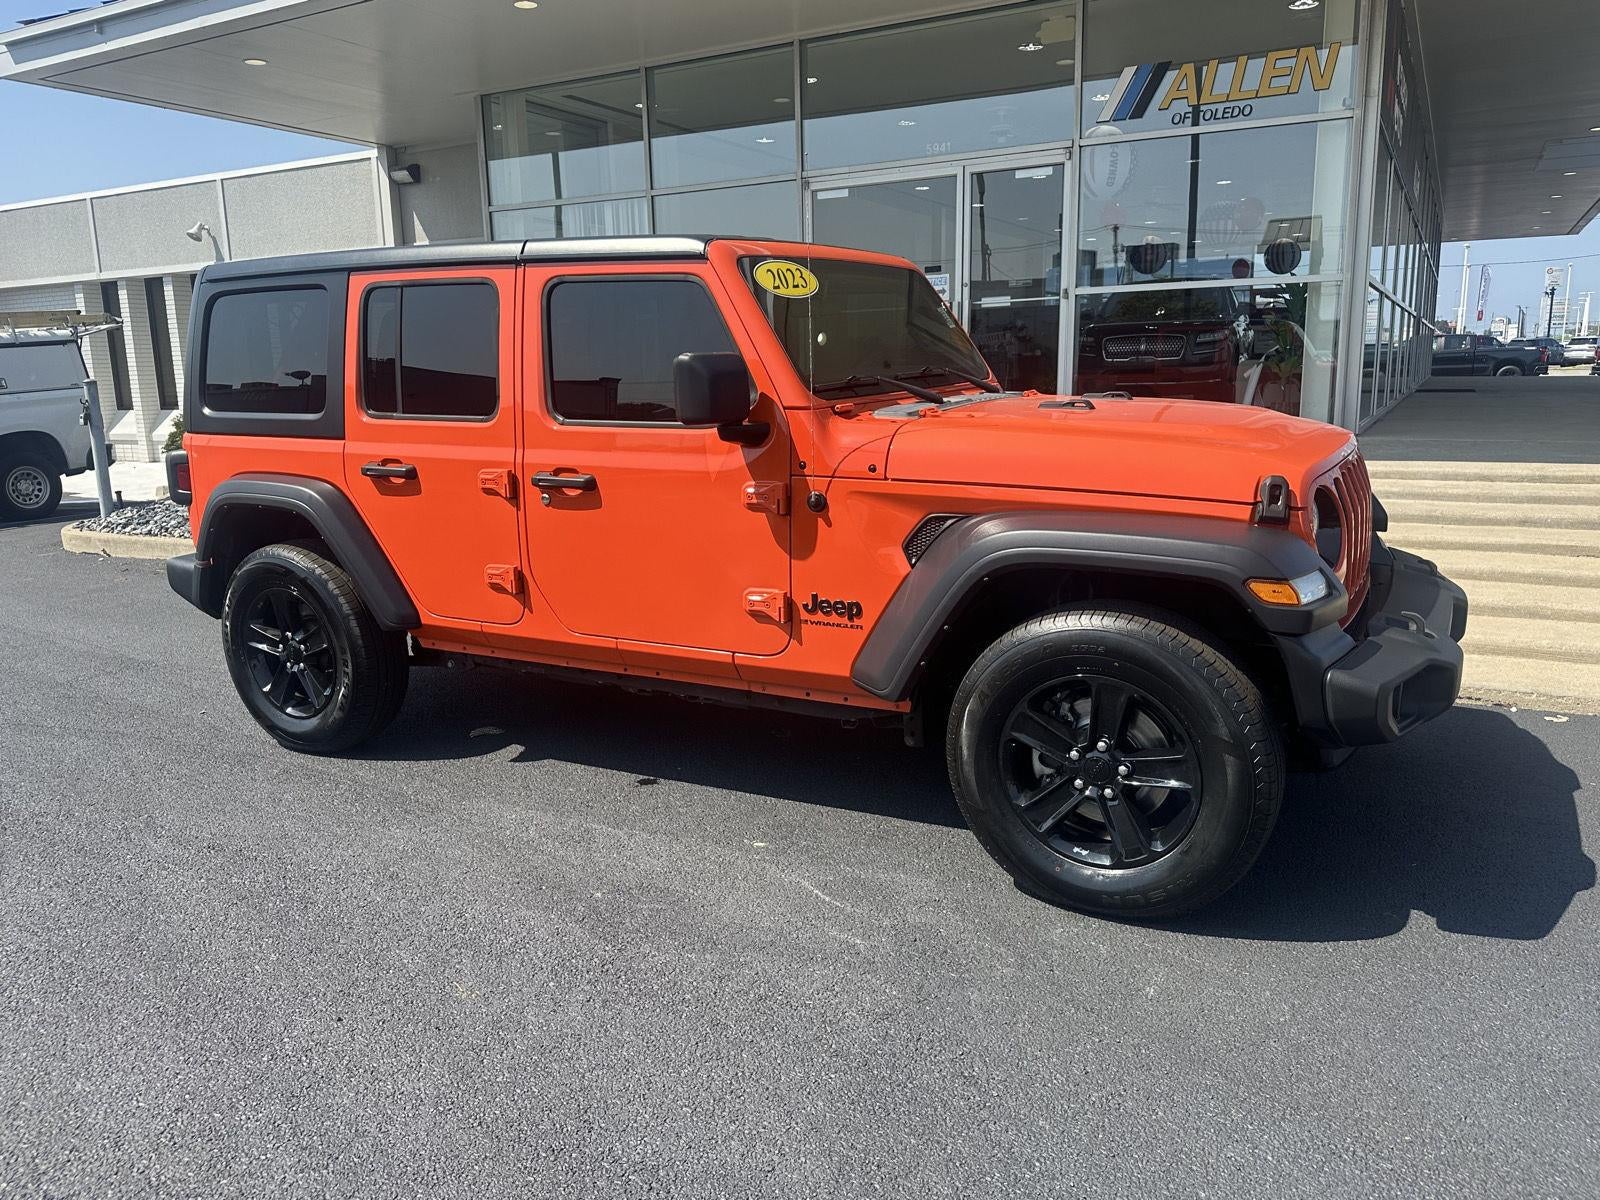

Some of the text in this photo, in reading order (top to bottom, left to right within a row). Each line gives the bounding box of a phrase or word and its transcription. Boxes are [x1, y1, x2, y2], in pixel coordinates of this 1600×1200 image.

[1158, 41, 1342, 111] ALLEN
[1171, 111, 1192, 125] OF
[926, 142, 951, 155] 5941
[766, 267, 808, 290] 2023
[802, 592, 863, 622] Jeep
[808, 620, 863, 630] WRANGLER
